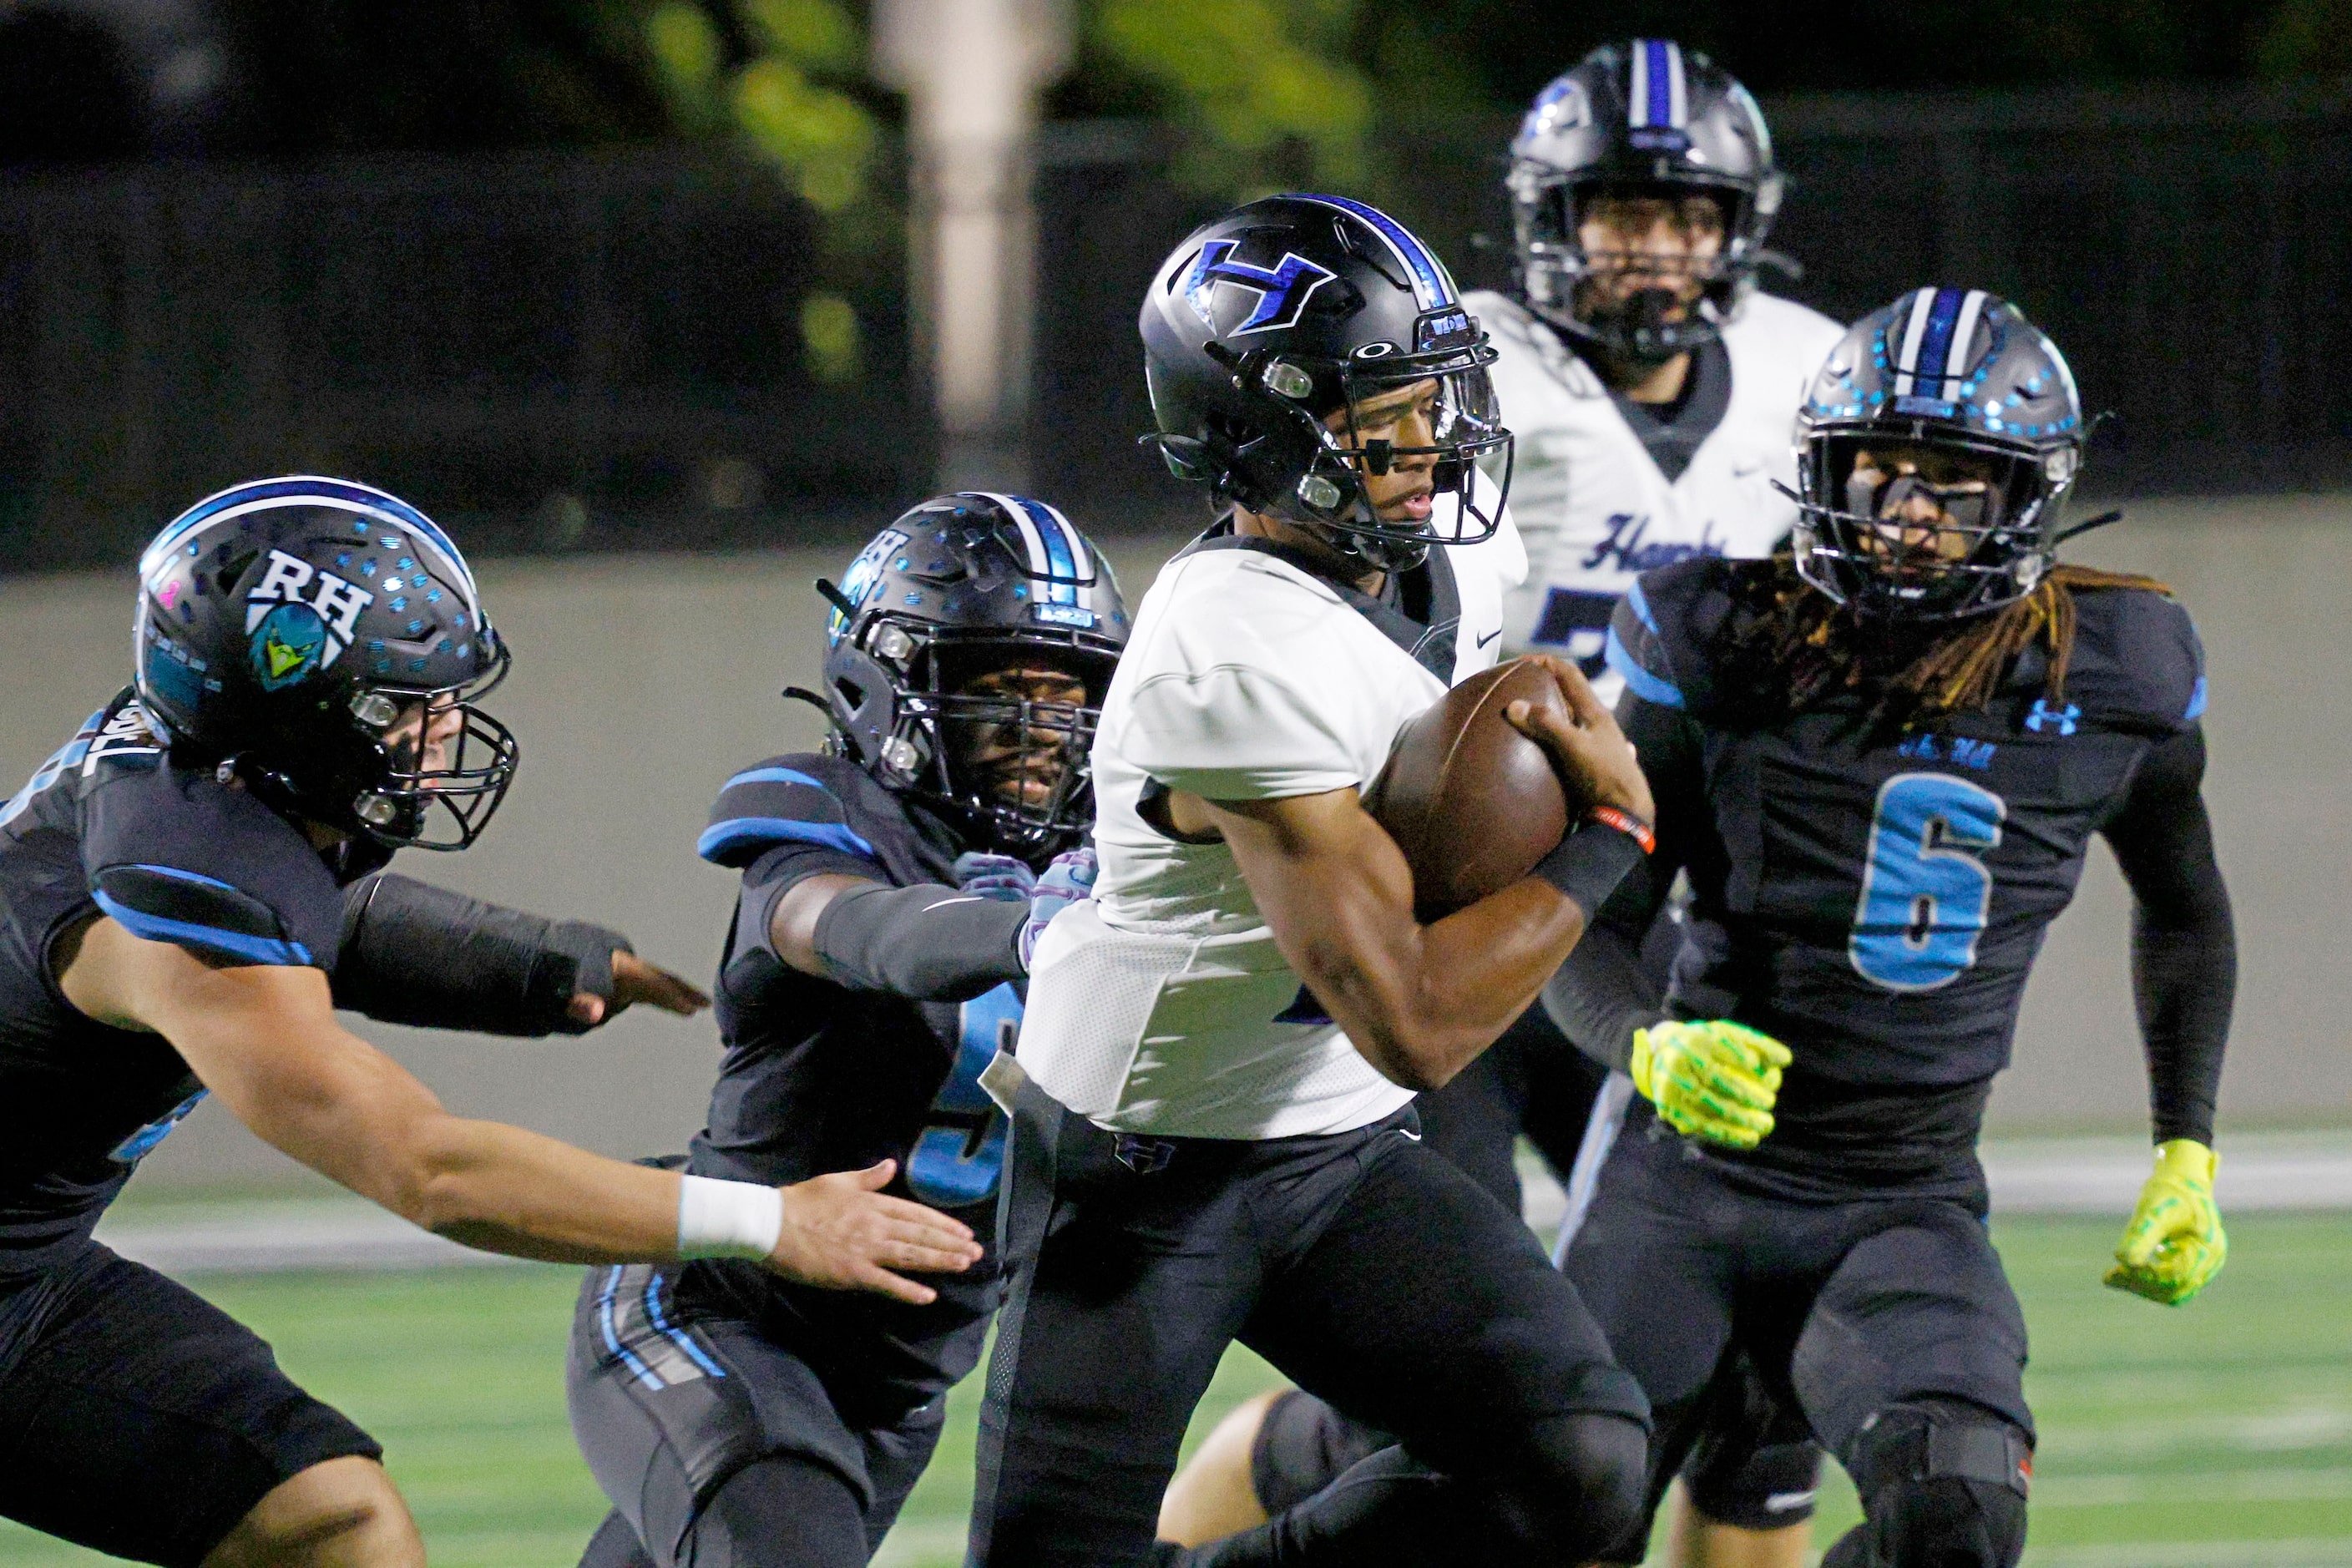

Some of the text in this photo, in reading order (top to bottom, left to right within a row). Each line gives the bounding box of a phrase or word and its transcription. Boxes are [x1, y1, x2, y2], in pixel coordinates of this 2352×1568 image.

[1185, 239, 1338, 337] H
[248, 549, 375, 646] RH
[1848, 771, 2008, 994] 6
